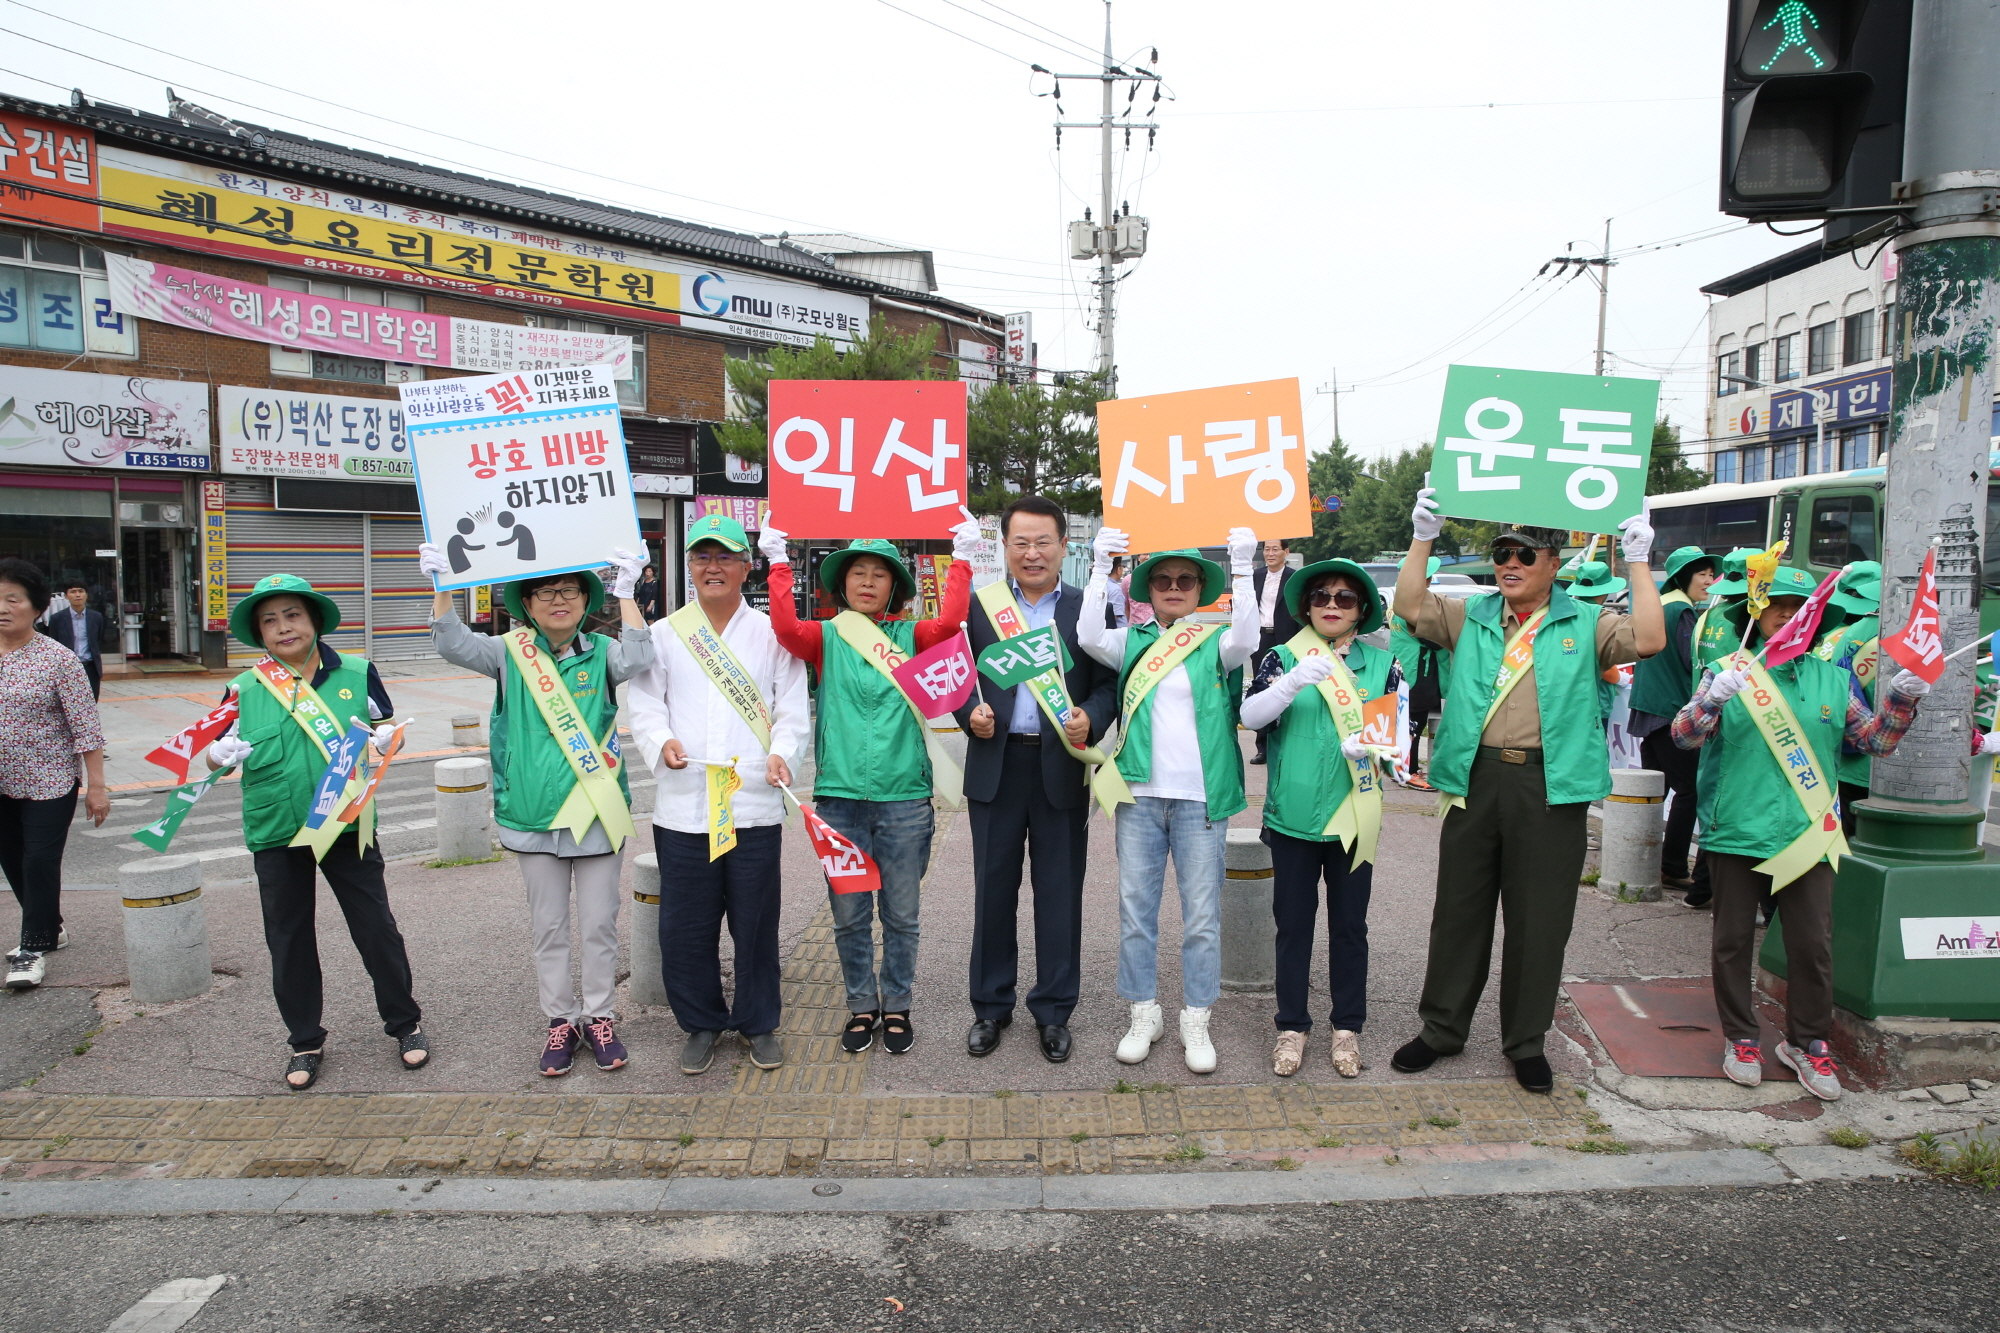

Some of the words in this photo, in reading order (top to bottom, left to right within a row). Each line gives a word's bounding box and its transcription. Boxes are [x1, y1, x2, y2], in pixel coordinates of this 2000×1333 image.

[495, 288, 563, 306] 843-1179
[227, 287, 438, 359] 혜성요리학원
[405, 386, 430, 397] 나부터
[433, 383, 467, 395] 실천하는
[485, 375, 534, 414] 꼭!
[534, 369, 593, 387] 이것만은
[537, 386, 611, 405] 지켜주세요
[35, 402, 152, 438] 헤어샵
[408, 397, 485, 417] 익산사랑운동
[130, 453, 205, 468] T.853-1589
[468, 439, 532, 479] 상호
[542, 429, 609, 467] 비방
[773, 416, 959, 512] 익산
[1111, 416, 1297, 514] 사랑
[1444, 396, 1641, 510] 운동
[505, 470, 616, 509] 하지않기
[732, 471, 758, 481] world
[1147, 624, 1203, 672] 2018
[515, 631, 555, 693] 2018
[545, 693, 600, 773] 전국체전
[1762, 707, 1820, 790] 전국체전
